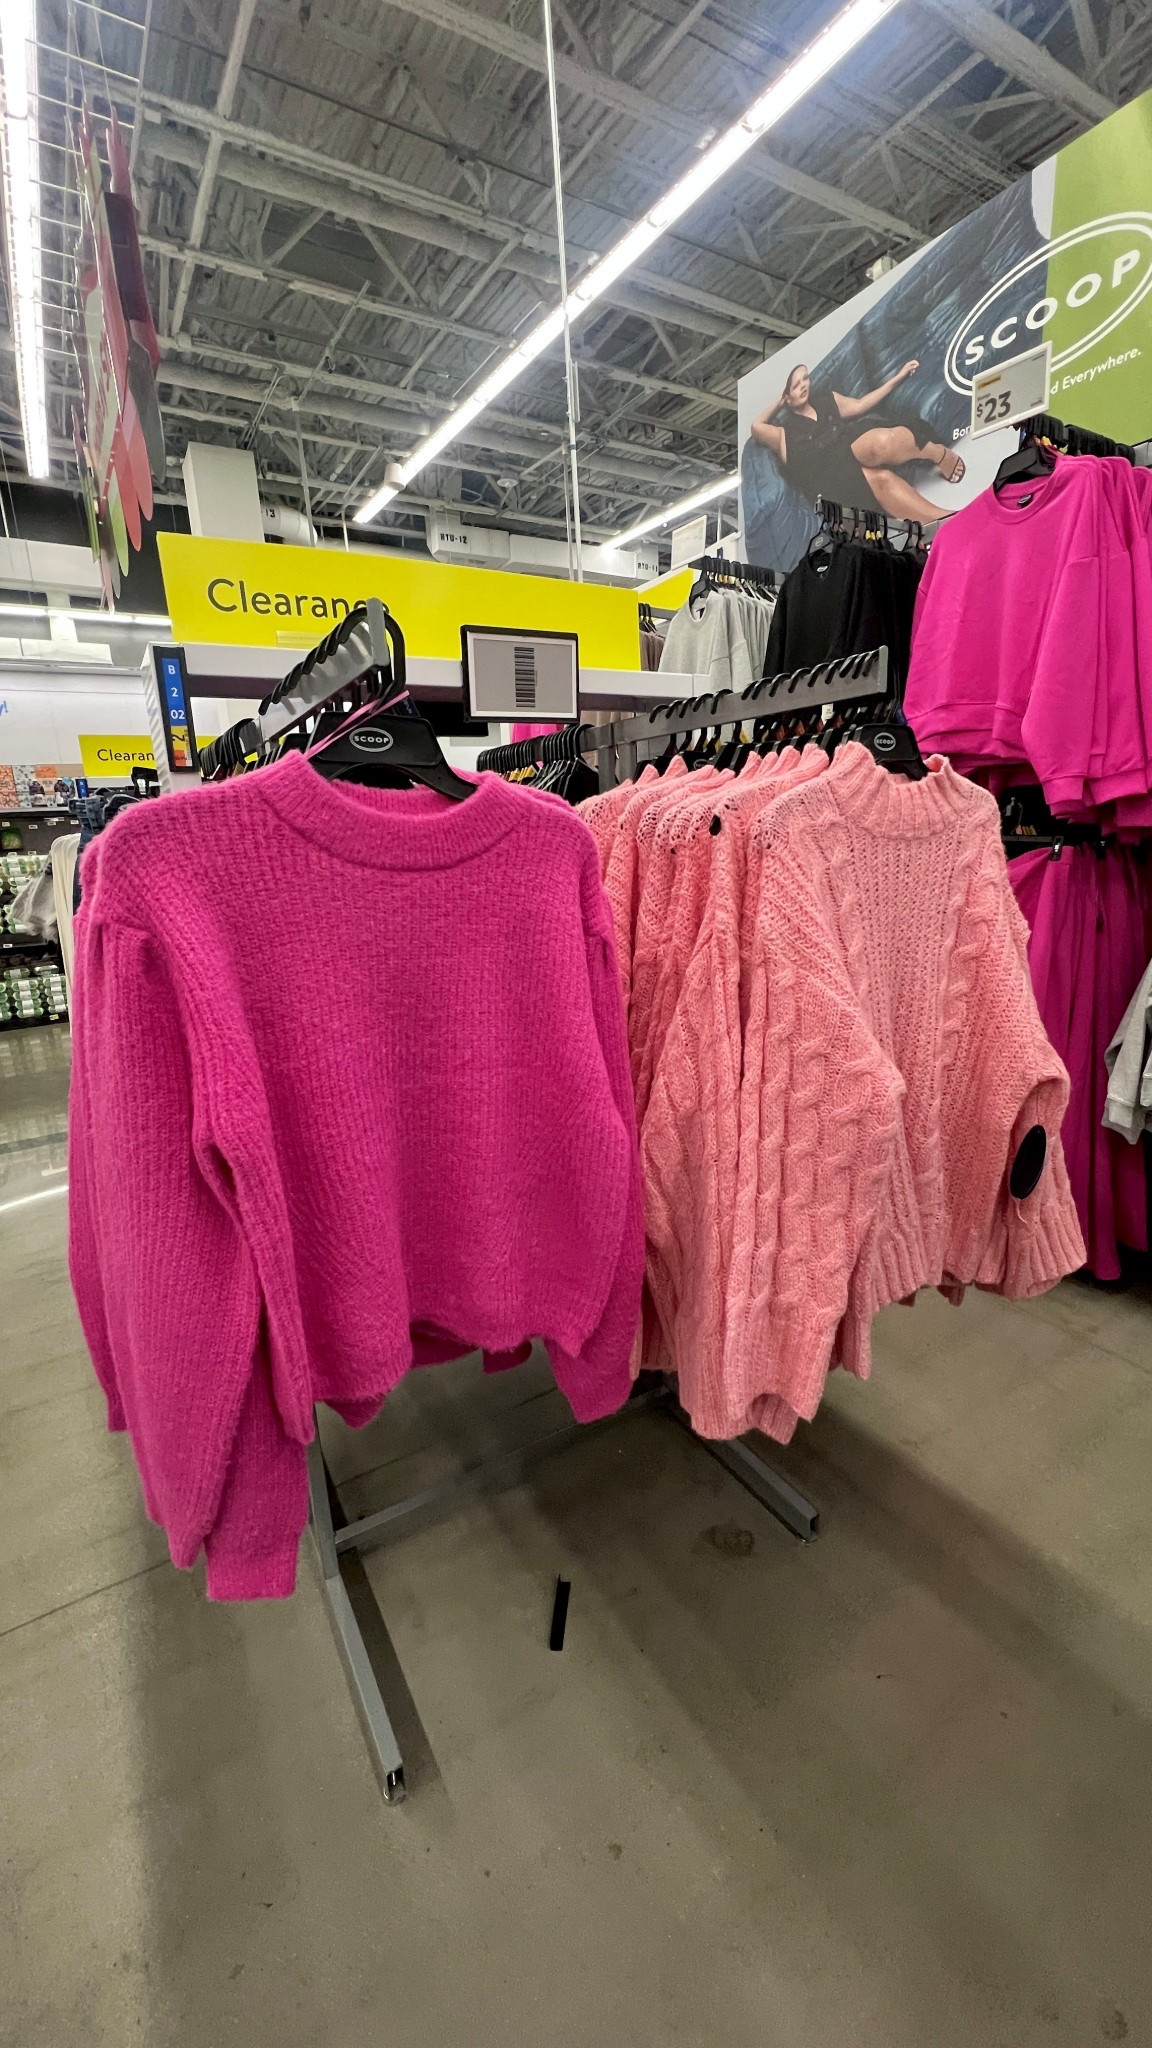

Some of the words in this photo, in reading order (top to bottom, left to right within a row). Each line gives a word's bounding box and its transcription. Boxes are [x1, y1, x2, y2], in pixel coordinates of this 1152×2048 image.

[965, 249, 1141, 366] SCOOP
[1062, 347, 1142, 390] Everywhere.
[976, 390, 1012, 424] $23
[440, 533, 468, 545] RTU-12
[207, 578, 390, 618] Clearan
[167, 664, 176, 675] B
[171, 687, 179, 697] 2
[170, 709, 186, 720] 02
[354, 735, 390, 744] SCOOP
